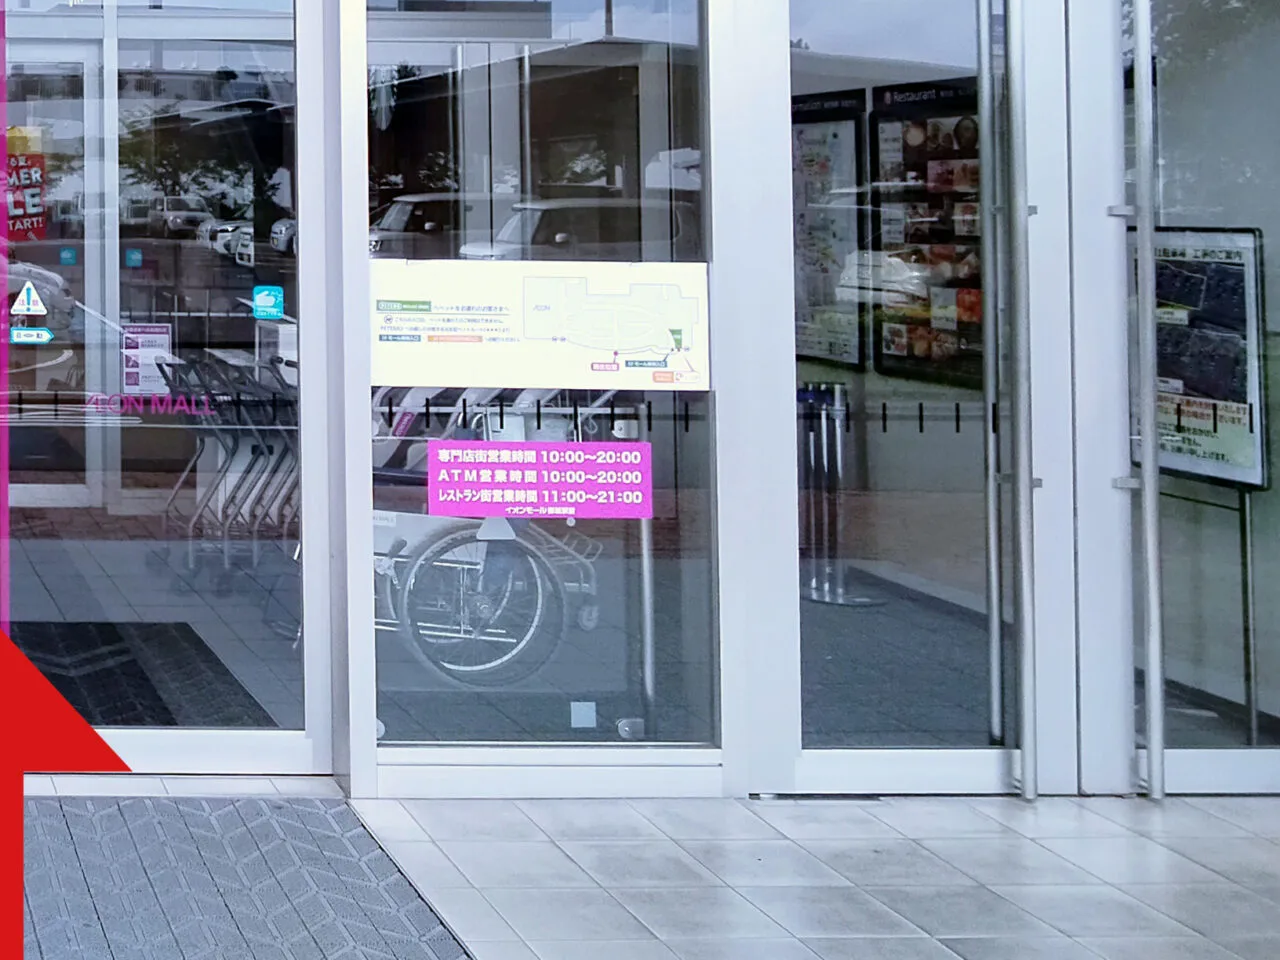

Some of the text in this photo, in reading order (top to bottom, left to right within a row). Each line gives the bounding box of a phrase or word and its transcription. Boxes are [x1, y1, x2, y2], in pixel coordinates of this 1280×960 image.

[893, 89, 937, 104] Restaurant
[151, 394, 216, 415] MALL
[438, 450, 537, 463] 専門店街営業時間
[439, 489, 538, 503] レストラン街営業時間
